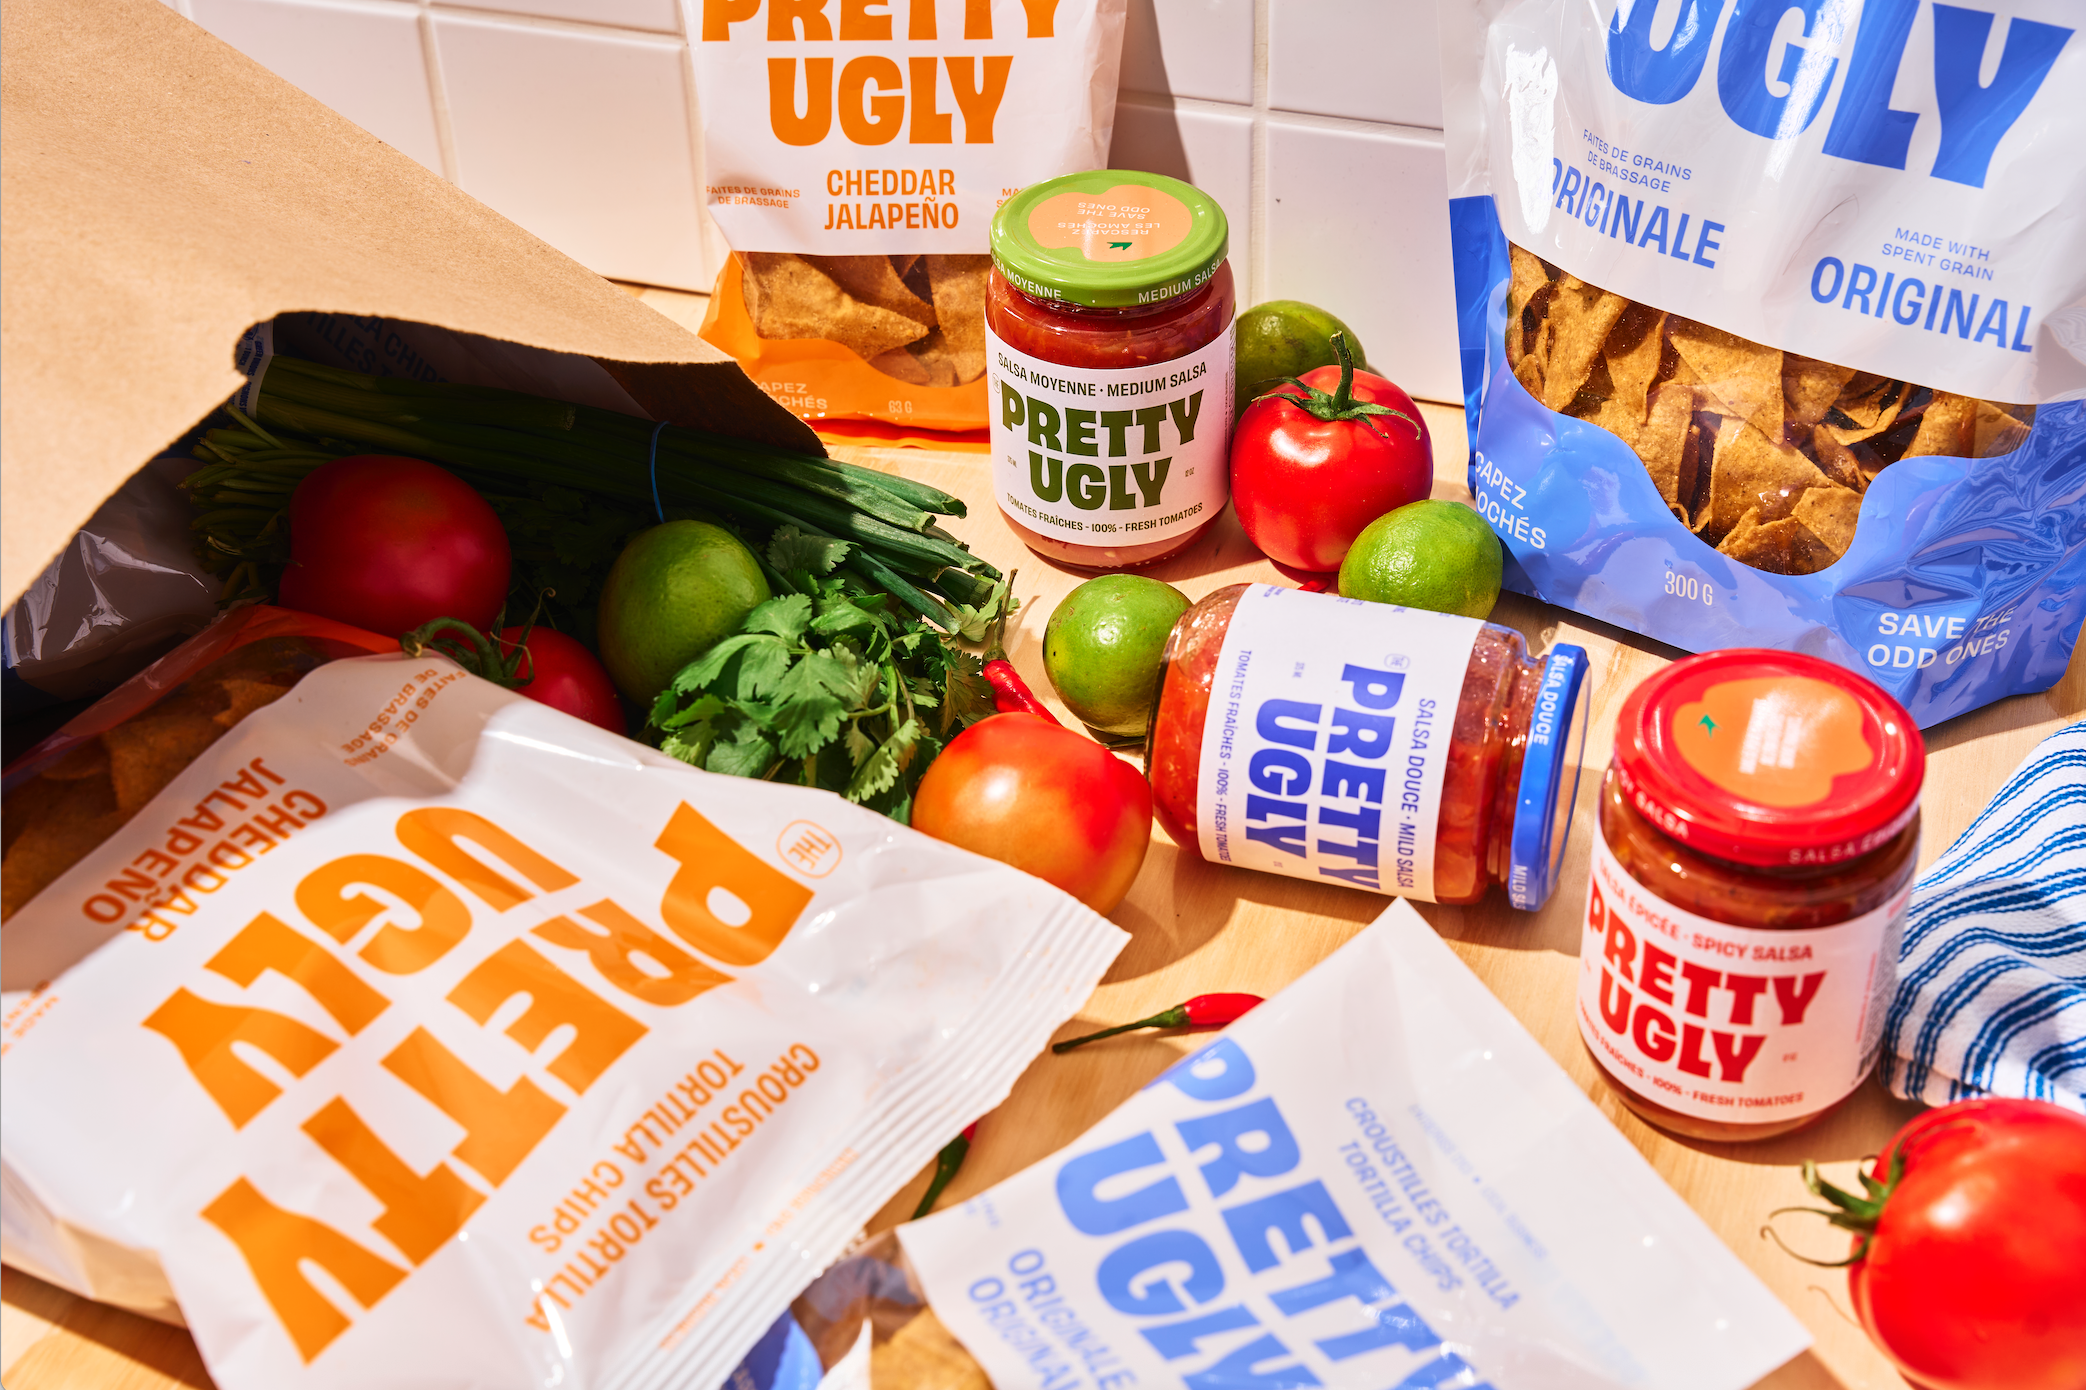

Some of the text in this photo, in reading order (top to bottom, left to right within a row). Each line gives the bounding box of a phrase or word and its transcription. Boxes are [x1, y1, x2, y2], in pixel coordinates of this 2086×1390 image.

[767, 55, 1014, 146] UGLY
[1606, 0, 2077, 190] UGLY
[1582, 128, 1693, 181] FAITES DE GRAINS
[1587, 150, 1672, 193] DE BRASSAGE
[706, 185, 801, 198] FAITES DE GRAINS
[717, 196, 790, 209] DE BRASSAGE
[826, 169, 956, 197] CHEDDAR
[1077, 202, 1150, 214] ODD ONES
[824, 196, 959, 230] JALAPEÑO
[1077, 208, 1146, 220] SAVE THE
[1881, 242, 1995, 282] SPENT GRAIN
[1894, 227, 1990, 262] MADE WITH
[991, 250, 1062, 300] ALSA MOYENNE
[1138, 258, 1221, 304] MEDIUM SALSA
[1810, 255, 2034, 354] ORIGINAL
[998, 351, 1028, 382] SALSA
[1030, 371, 1096, 397] MOYENNE
[1107, 376, 1166, 397] MEDIUM
[1169, 361, 1207, 388] SALSA
[888, 400, 913, 414] 63 G
[1000, 379, 1204, 457] PRETTY
[1028, 449, 1173, 511] UGLY
[1006, 492, 1038, 519] TOMATES
[1039, 511, 1083, 532] FRAÎCHES
[1091, 522, 1117, 533] 100%
[1125, 519, 1157, 532] FRESH
[1159, 502, 1203, 527] TOMATOES
[1476, 486, 1547, 550] OCHÉS
[1664, 571, 1713, 606] 300 G
[1878, 604, 2019, 640] SAVE THE
[1229, 649, 1252, 700] TOMATES
[1867, 629, 2011, 670] ODD ONES
[341, 668, 438, 754] DE BRASSAGE
[395, 709, 419, 733] DE
[1219, 701, 1240, 760] FRAÎCHES
[1410, 698, 1436, 750] SALSA
[1533, 688, 1559, 746] DOUCE
[1216, 767, 1229, 796] 100%
[1245, 698, 1323, 860] UGLY
[1317, 663, 1407, 890] PRETTY
[1401, 755, 1425, 814] DOUCE
[1214, 802, 1227, 832] FRESH
[1396, 822, 1416, 857] MILD
[1635, 790, 1689, 840] SALSA
[82, 756, 287, 925] JALAPEÑO
[124, 789, 328, 942] CHEDDAR
[787, 829, 833, 871] THE
[1396, 858, 1415, 888] SALSA
[140, 806, 582, 1132] UGLY
[1588, 873, 1828, 1028] PRETTY
[1691, 932, 1749, 960] SPICY
[1751, 944, 1814, 963] SALSA
[1599, 964, 1768, 1084] UGLY
[199, 800, 816, 1368] PRETTY
[1692, 1090, 1735, 1107] FRESH
[1737, 1091, 1805, 1108] TOMATOES
[527, 1047, 746, 1254] TORTILLA CHIPS
[524, 1042, 820, 1333] CROUSTILLES TORTILLA
[1345, 1096, 1521, 1312] CROUSTILLES TORTILLA
[1338, 1139, 1464, 1292] TORTILLA CHIPS
[1055, 1130, 1327, 1390] UGLY
